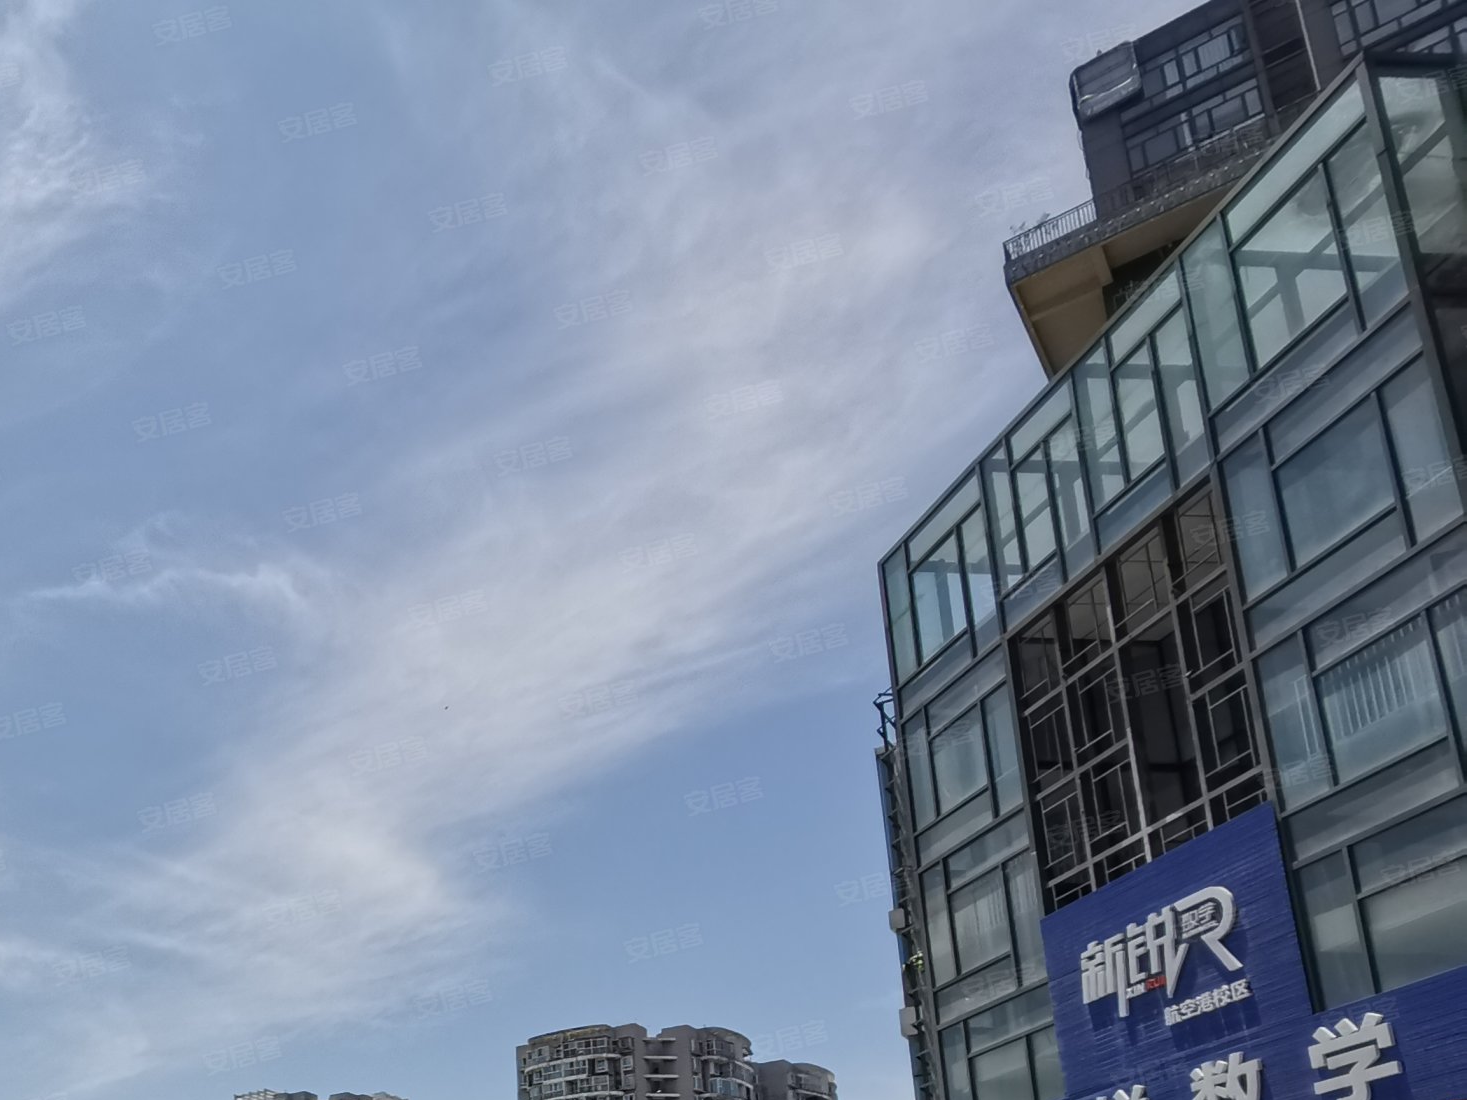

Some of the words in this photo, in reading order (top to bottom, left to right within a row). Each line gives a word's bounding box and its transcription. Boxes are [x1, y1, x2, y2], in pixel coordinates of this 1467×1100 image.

[1164, 978, 1254, 1026] 航空港校区
